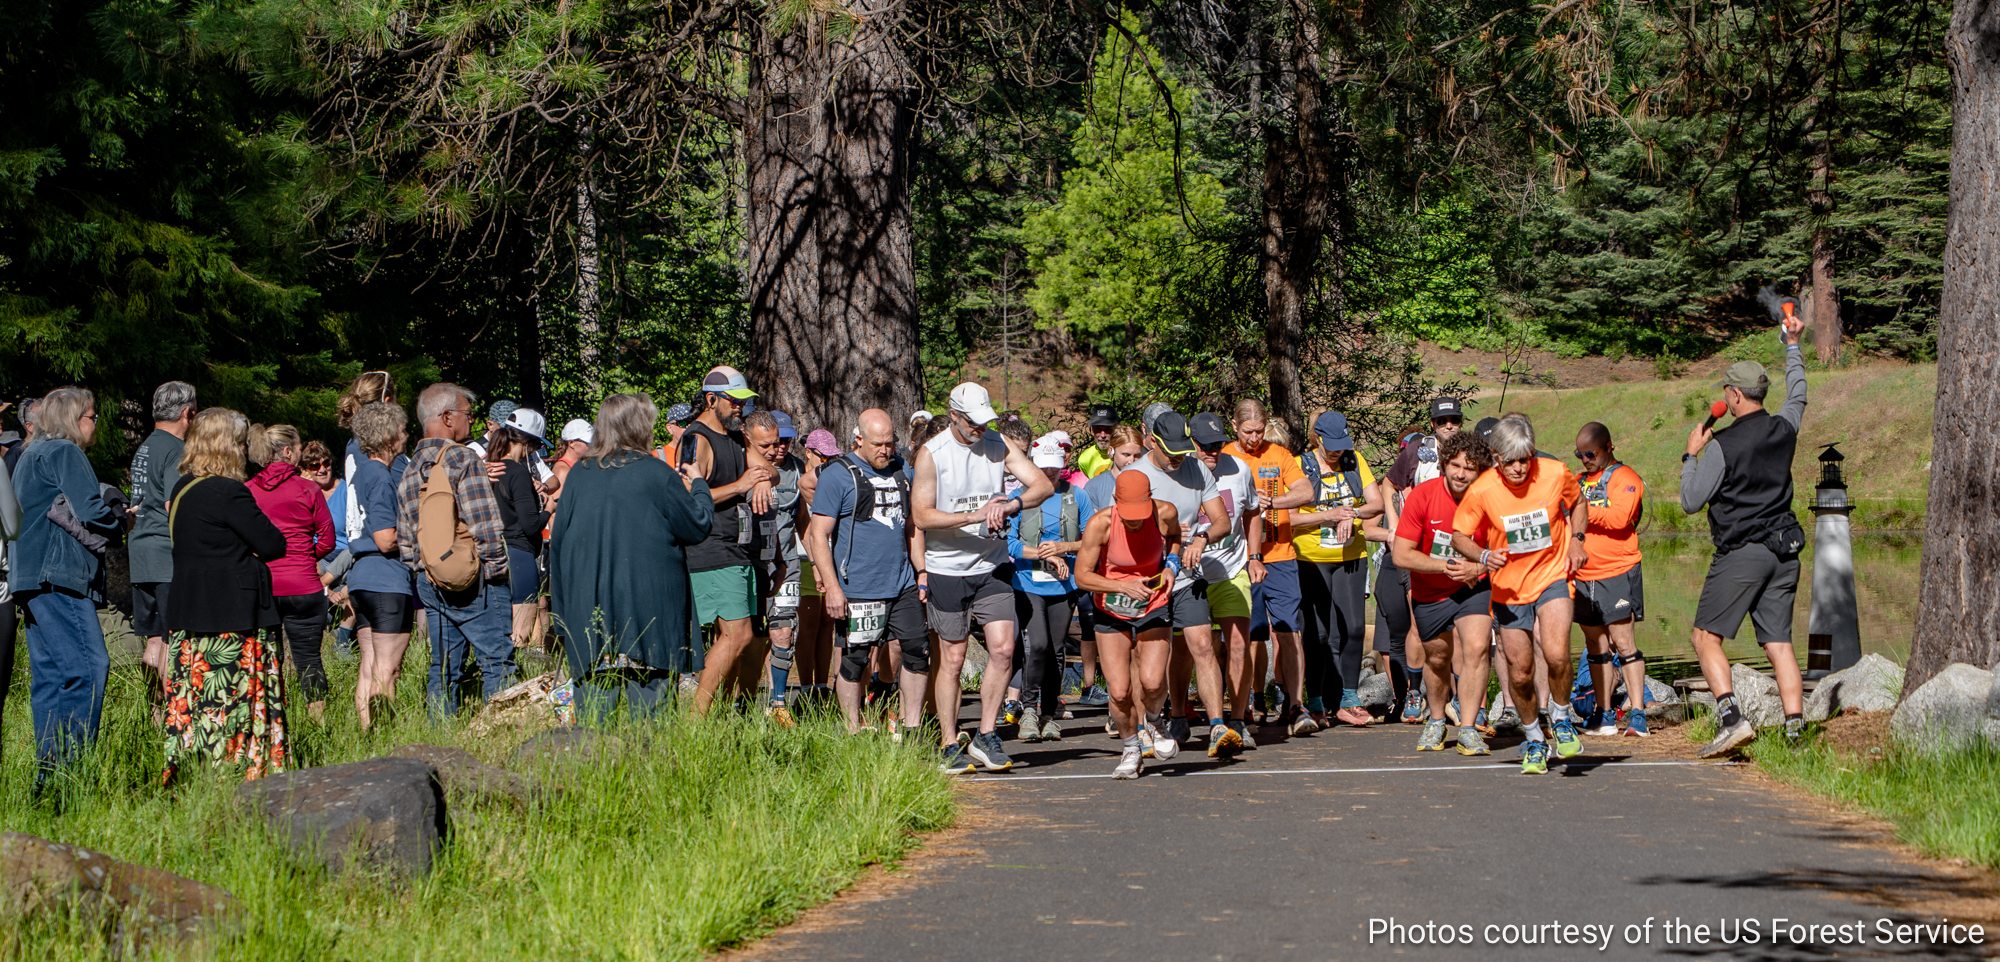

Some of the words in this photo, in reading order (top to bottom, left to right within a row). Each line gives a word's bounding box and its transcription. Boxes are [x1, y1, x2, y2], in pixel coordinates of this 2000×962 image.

[1508, 516, 1520, 524] RUN
[1532, 511, 1543, 519] RIM
[1514, 525, 1543, 543] 143
[779, 583, 799, 596] 146
[856, 616, 879, 631] 103
